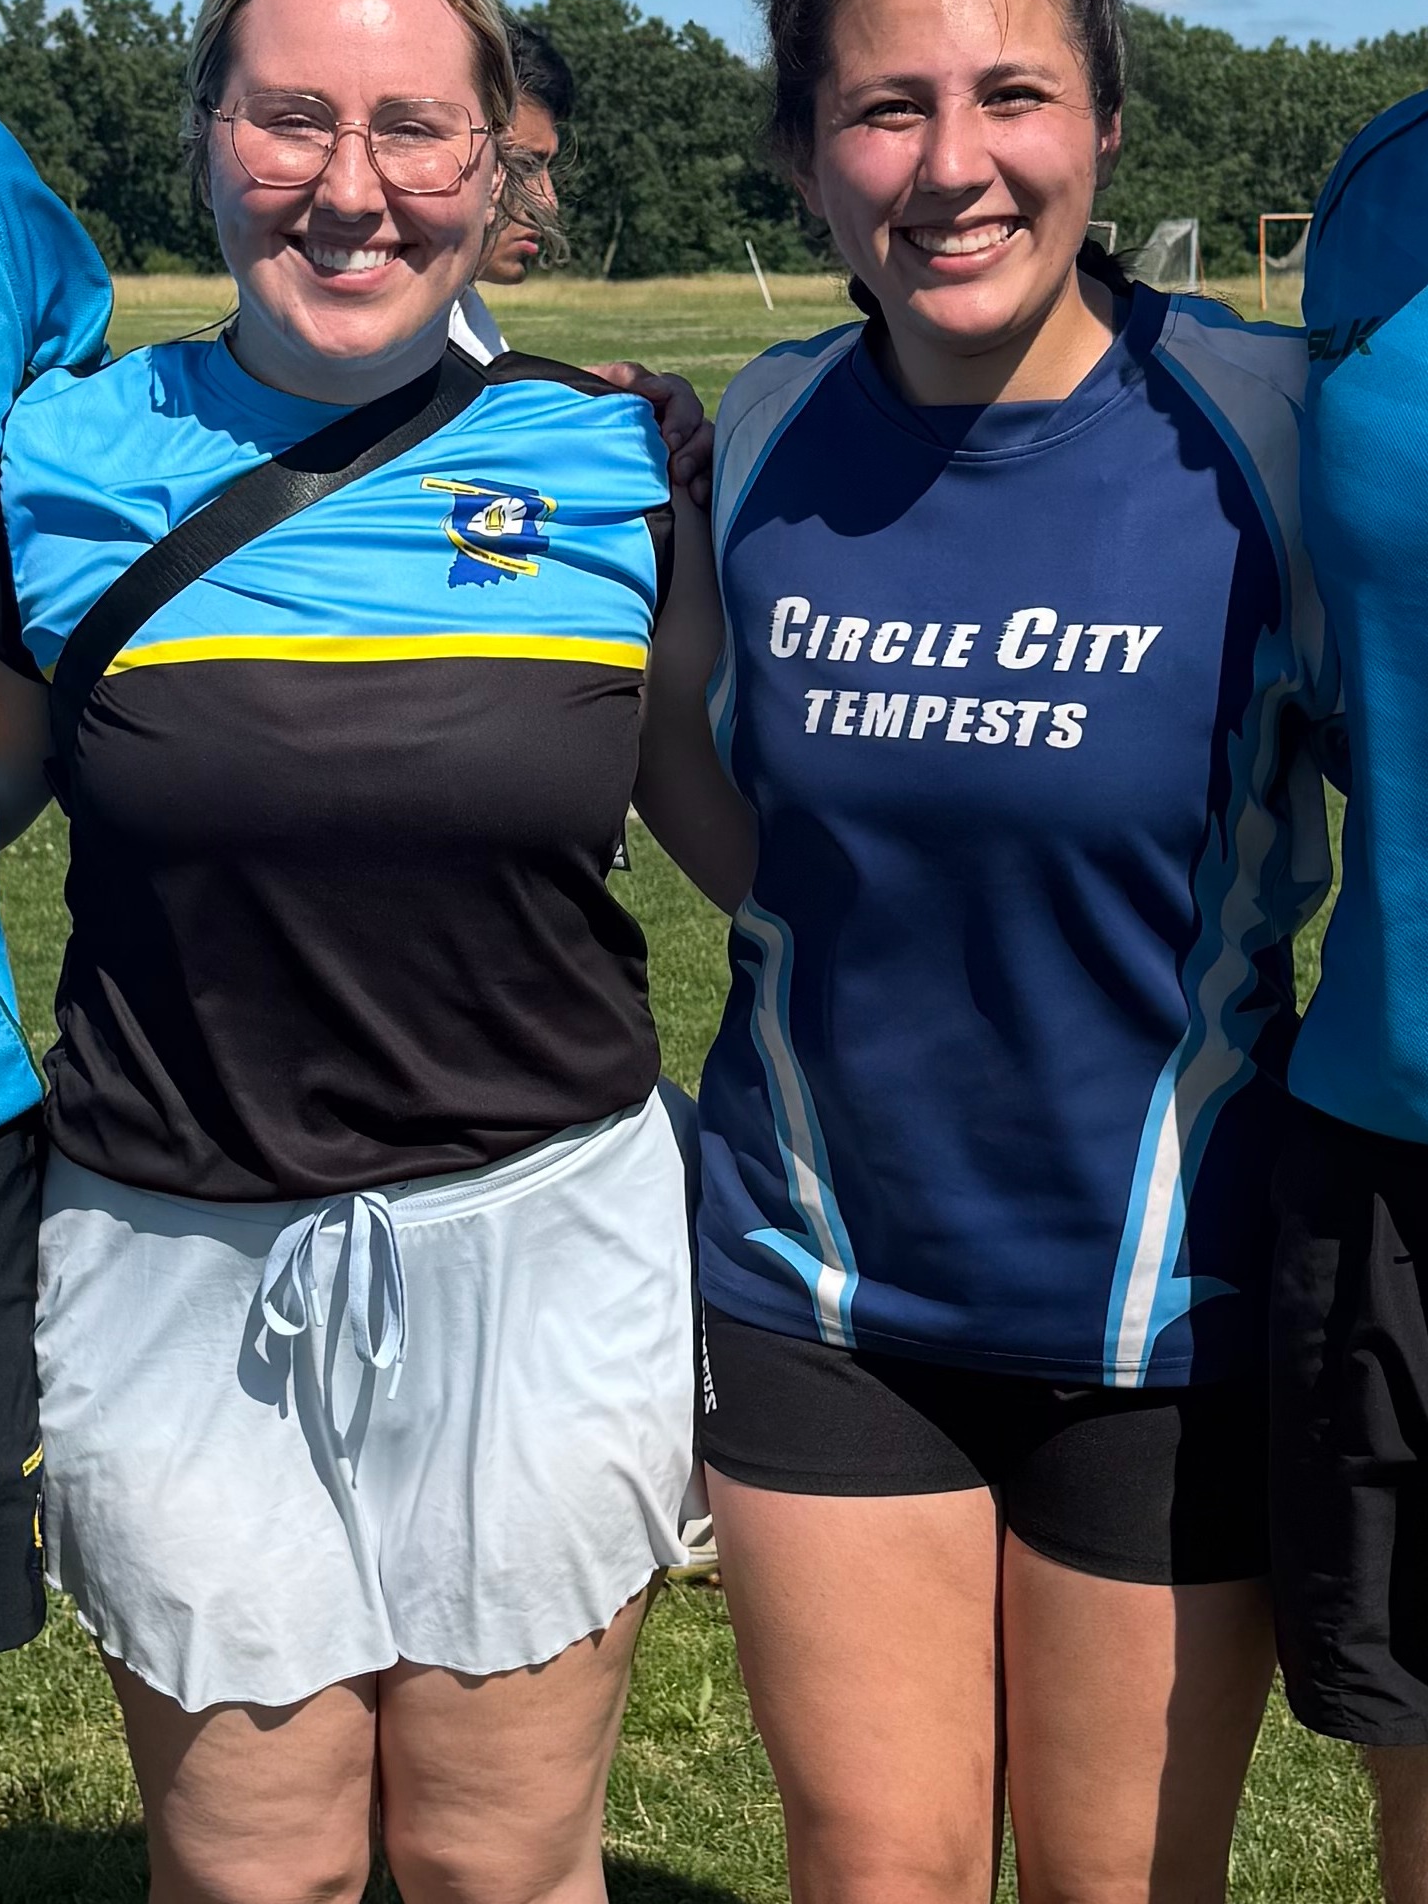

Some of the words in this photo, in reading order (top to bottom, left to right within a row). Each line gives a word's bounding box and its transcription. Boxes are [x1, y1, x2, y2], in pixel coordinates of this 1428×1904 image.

[770, 596, 981, 669] CIRCLE
[994, 607, 1164, 674] CITY
[803, 689, 1088, 749] TEMPESTS
